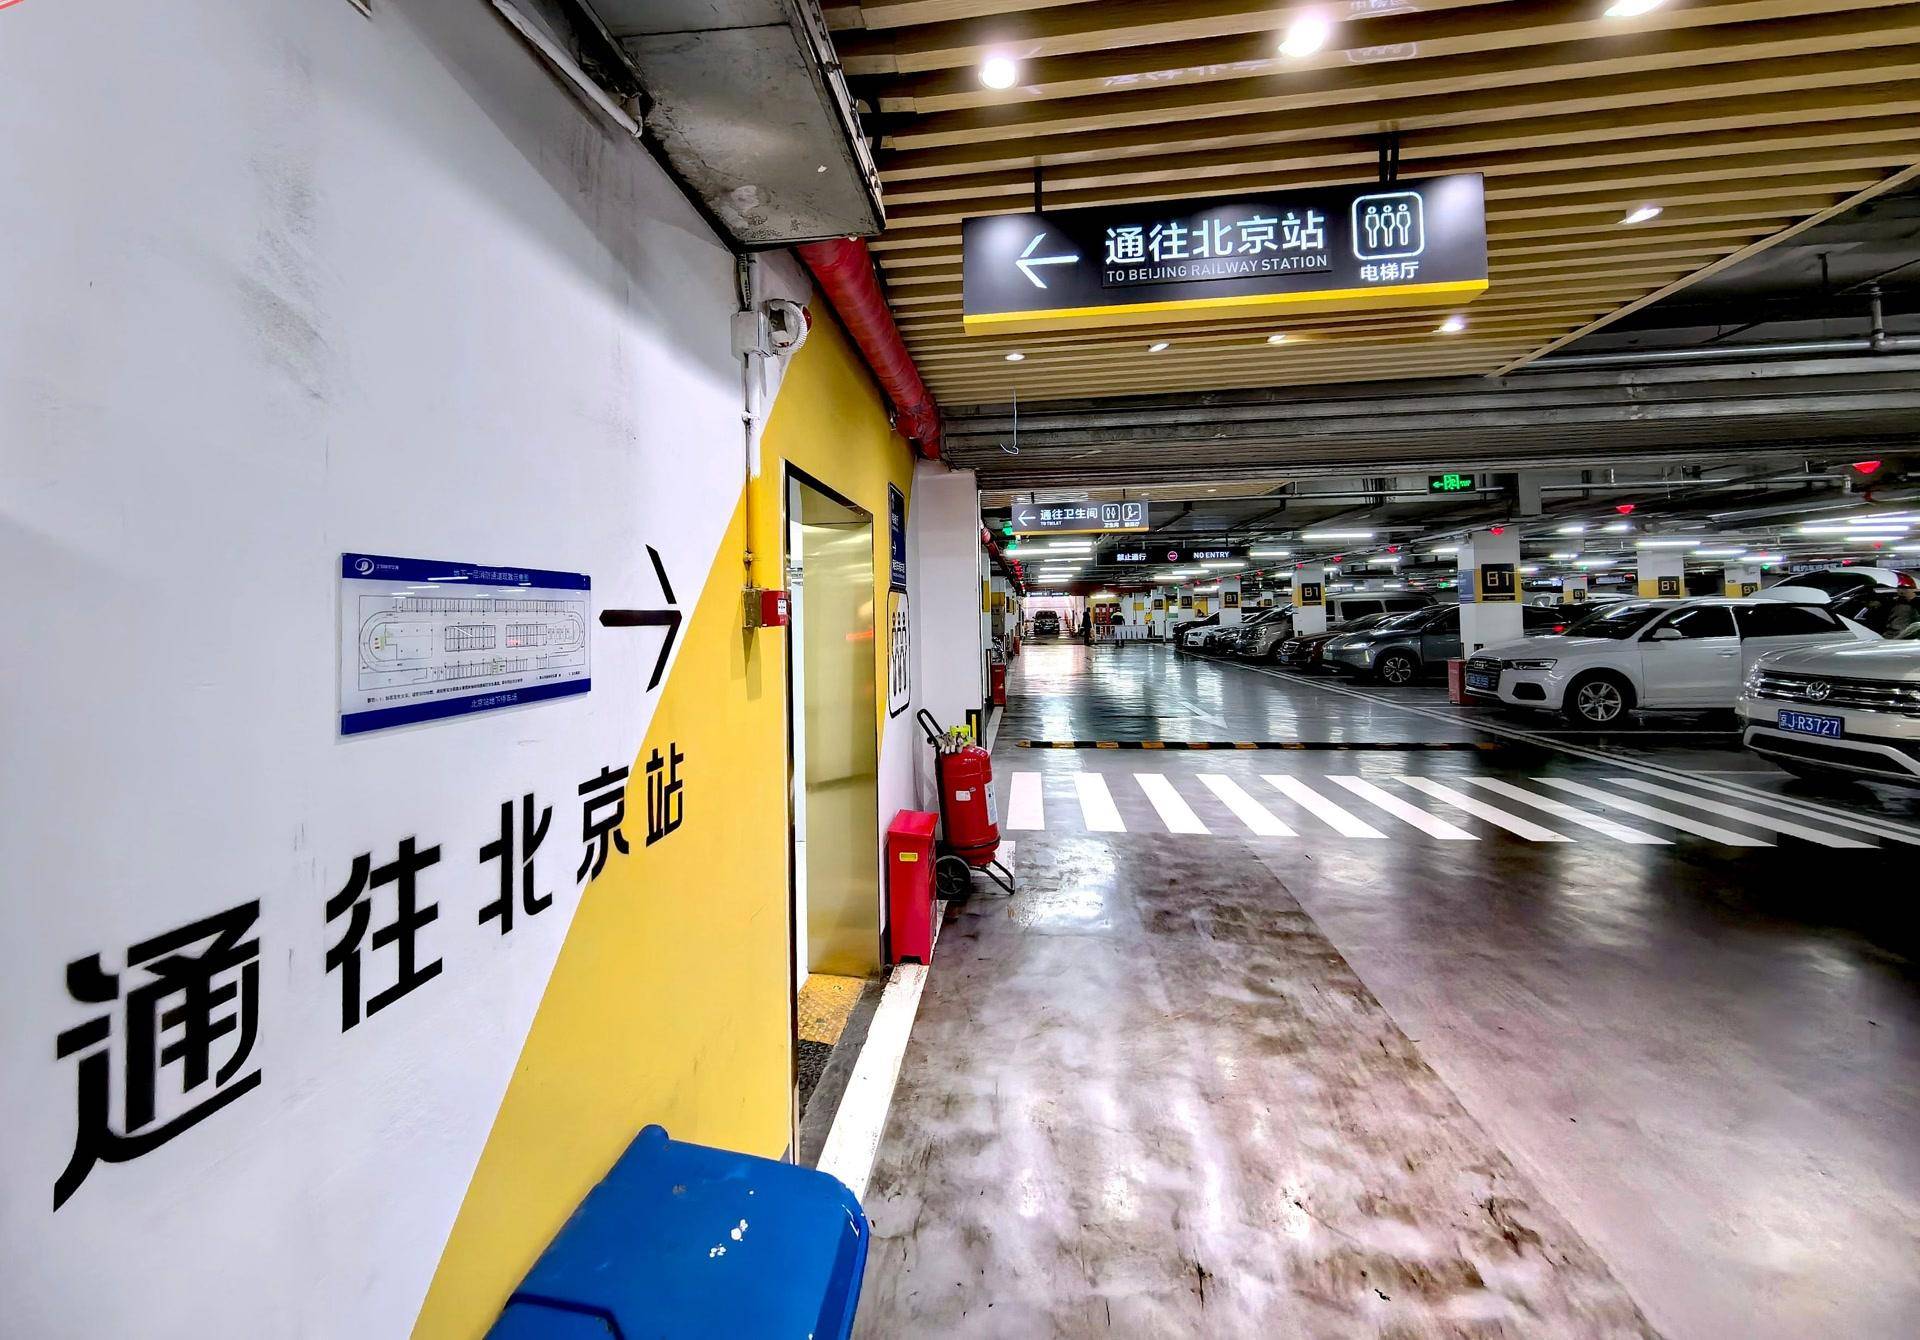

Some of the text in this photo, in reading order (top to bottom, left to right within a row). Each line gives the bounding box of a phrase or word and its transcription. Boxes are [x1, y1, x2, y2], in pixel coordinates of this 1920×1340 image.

[1105, 210, 1325, 265] 通往北京站
[1107, 254, 1328, 283] TO BEIJING RAILWAY STATION
[1360, 261, 1419, 282] 电梯厅
[1040, 507, 1098, 521] 通往卫生间
[1205, 551, 1230, 559] ENTRY
[1487, 571, 1511, 586] B1
[1661, 580, 1677, 591] B1
[1226, 594, 1237, 602] B1
[1304, 586, 1319, 598] B1
[53, 741, 684, 1213] 通往北京站
